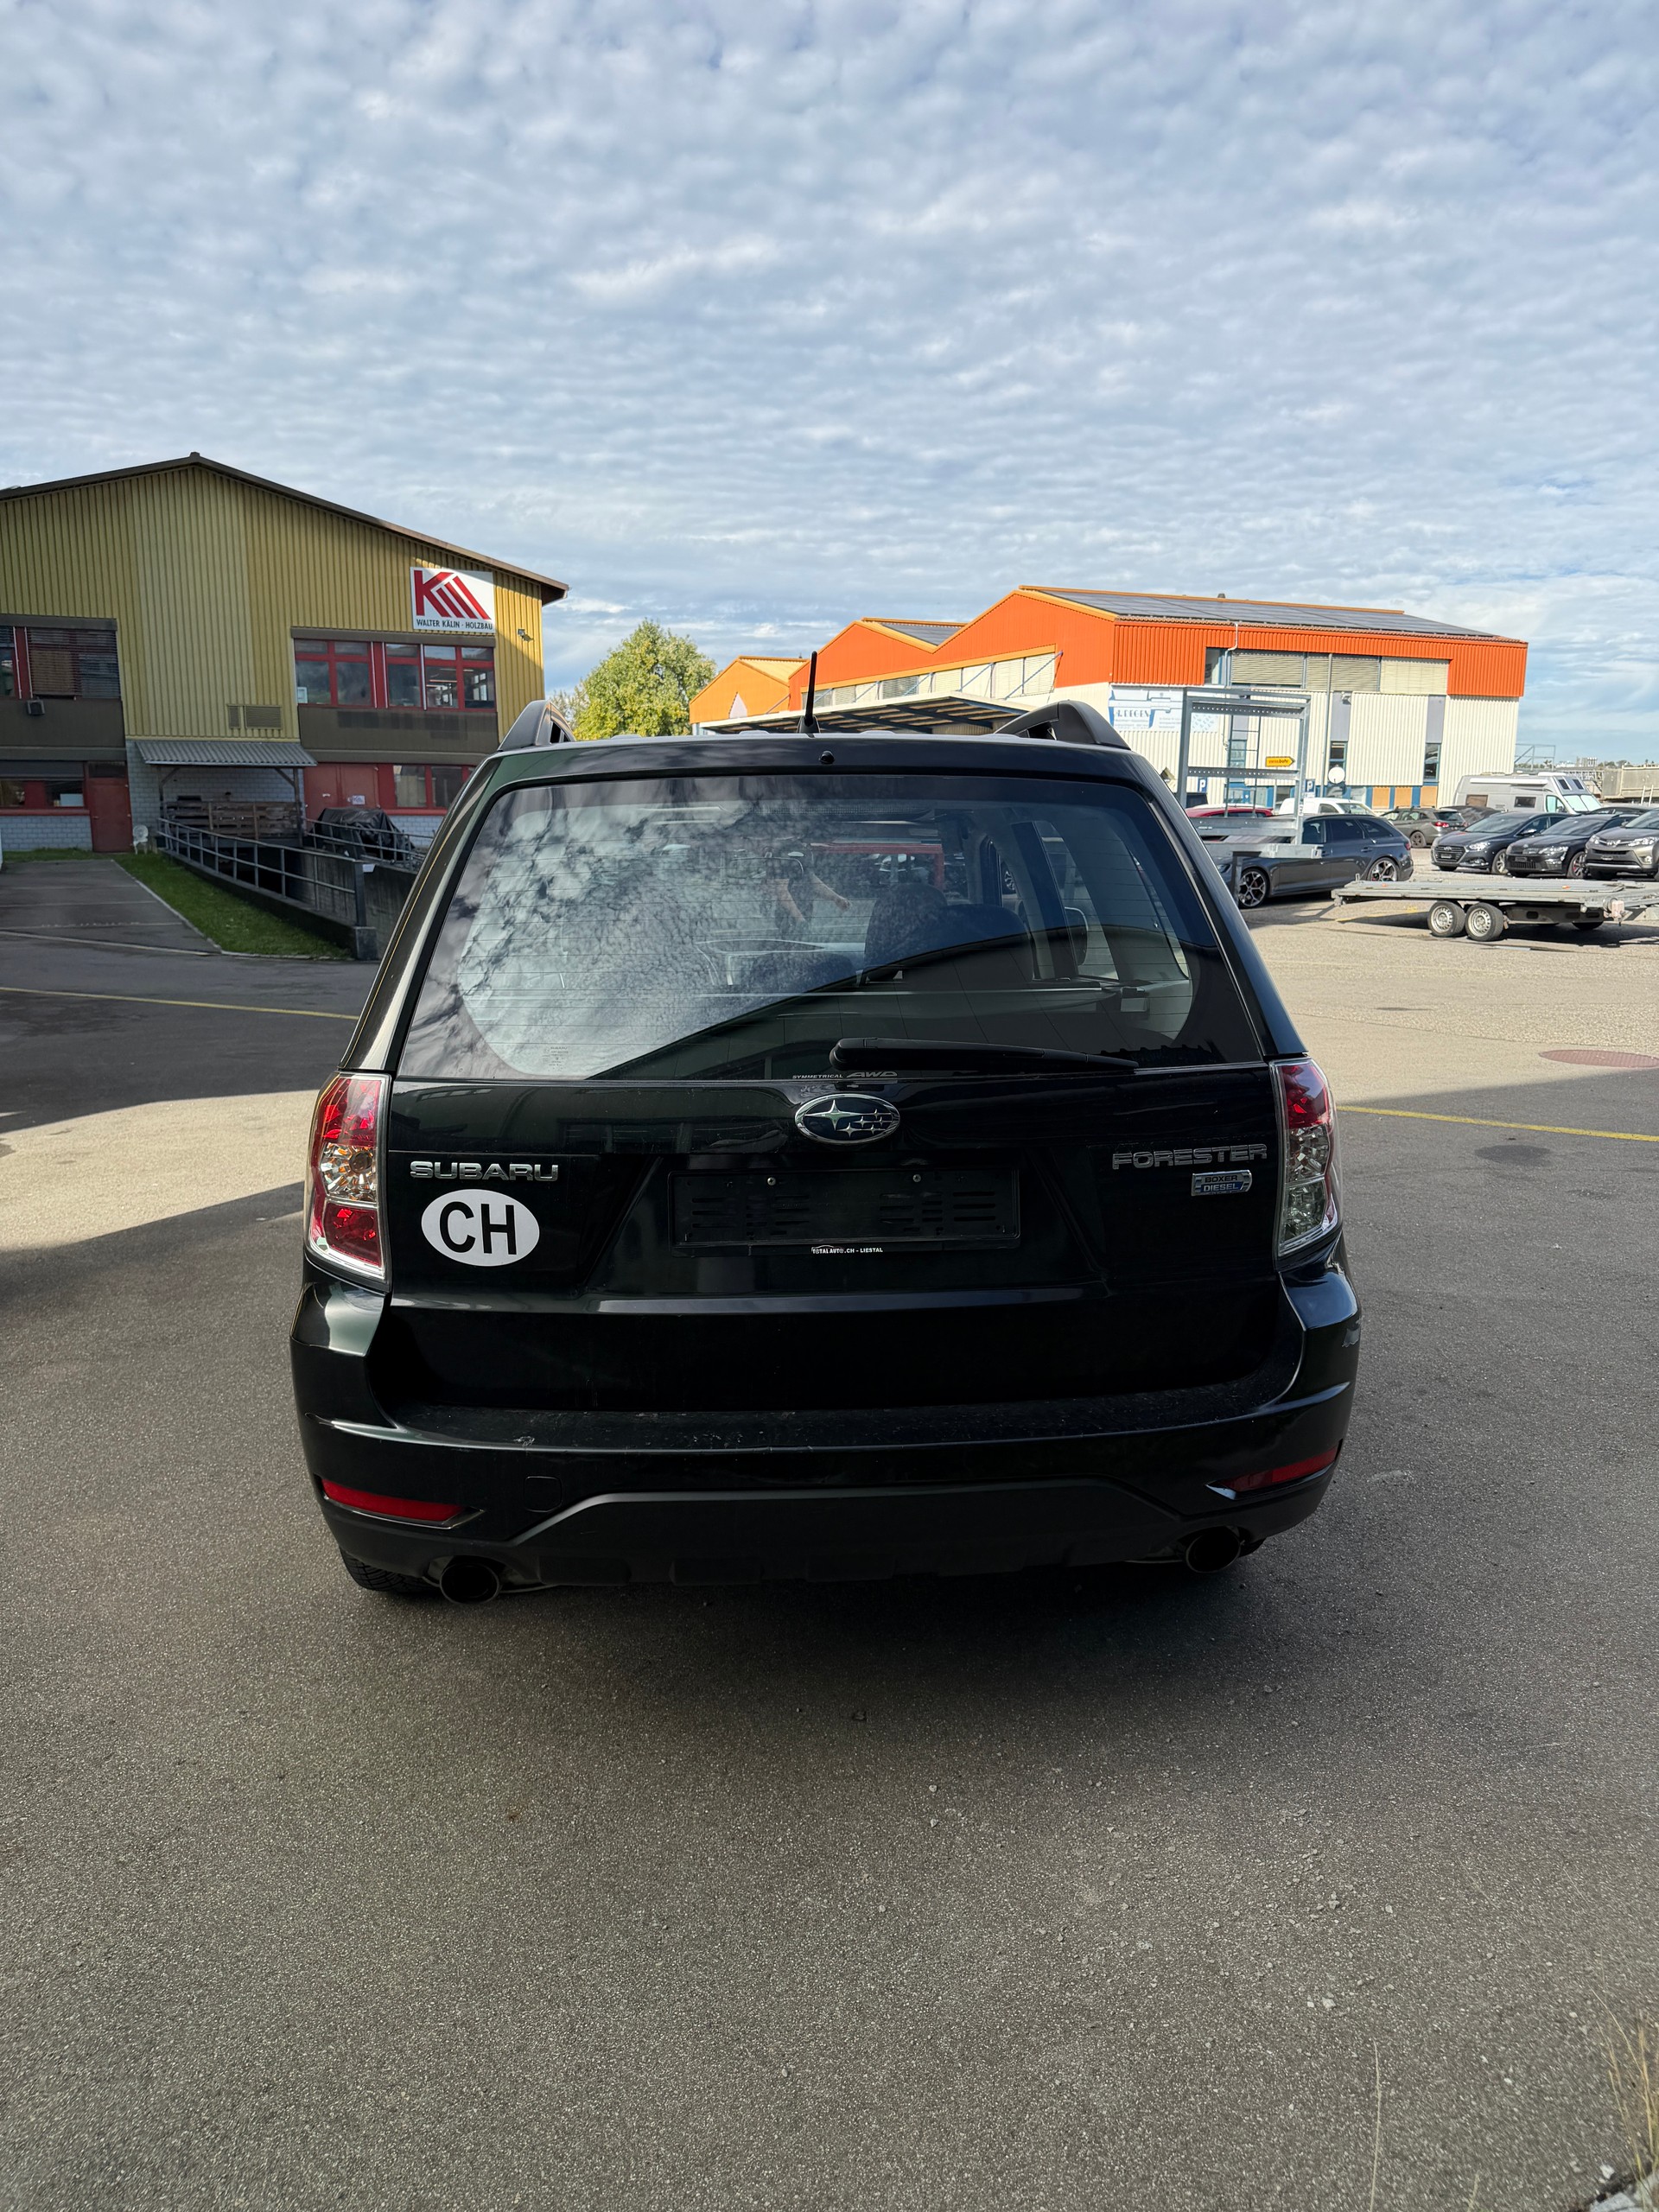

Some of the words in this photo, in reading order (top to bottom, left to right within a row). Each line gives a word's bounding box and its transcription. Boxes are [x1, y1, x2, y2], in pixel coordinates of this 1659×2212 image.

[416, 619, 440, 627] WALTER
[442, 620, 460, 628] KÄLIN
[465, 621, 493, 630] HOLZBAU
[1199, 779, 1206, 792] P
[1306, 780, 1313, 792] P
[1112, 1143, 1268, 1170] FORESTER
[410, 1160, 559, 1181] SUBARU
[1203, 1183, 1239, 1192] DIESEL
[439, 1201, 517, 1255] CH
